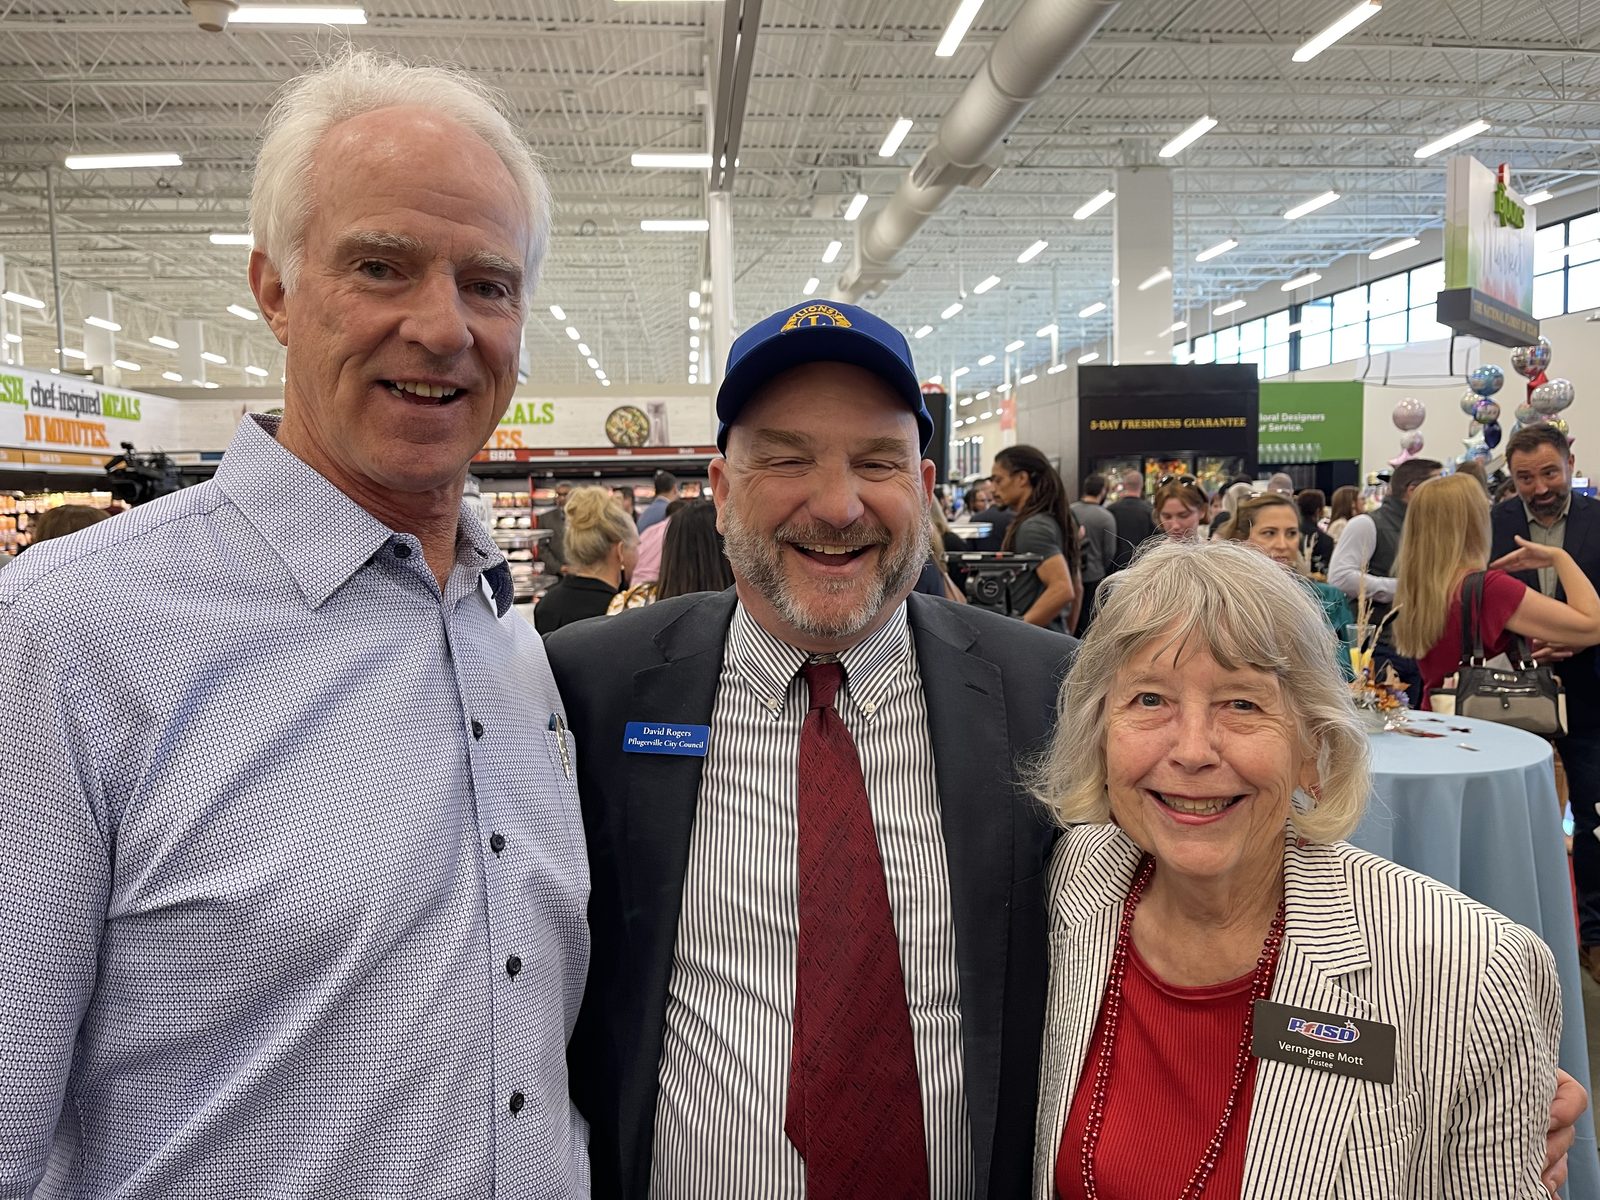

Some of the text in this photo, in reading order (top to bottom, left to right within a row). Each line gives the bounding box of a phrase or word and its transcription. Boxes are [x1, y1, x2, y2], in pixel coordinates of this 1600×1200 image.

[799, 305, 835, 317] LIONS
[31, 380, 100, 418] chef-inspired
[102, 393, 141, 420] MEALS
[1122, 418, 1182, 429] FRESHNESS
[1184, 417, 1247, 428] GUARANTEE
[1281, 412, 1325, 423] Designers
[24, 414, 41, 441] IN
[486, 430, 528, 449] ES.
[643, 727, 691, 738] David Rogers
[628, 738, 704, 749] Pflugerville City Council
[1278, 1040, 1364, 1066] Vernagene Mott
[1307, 1057, 1334, 1069] Trustee
